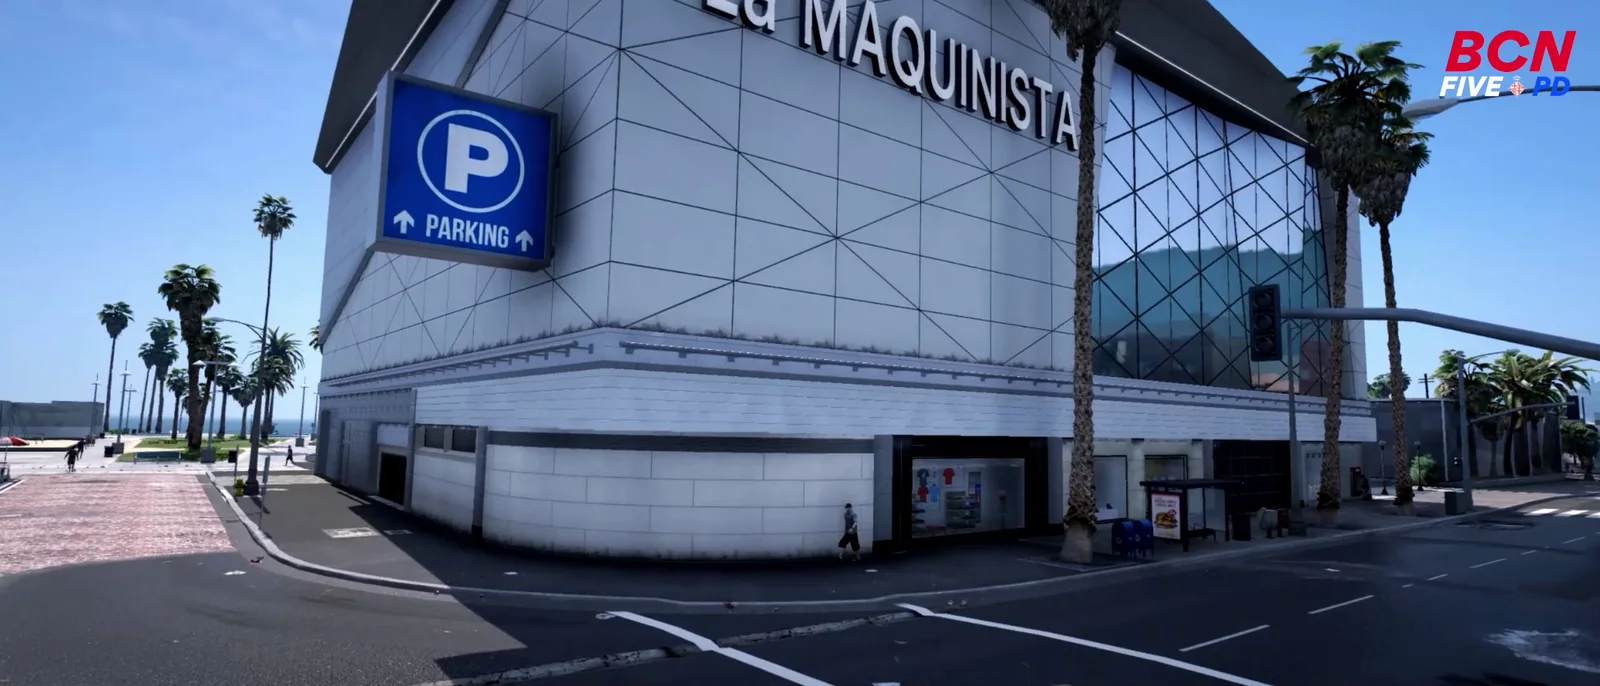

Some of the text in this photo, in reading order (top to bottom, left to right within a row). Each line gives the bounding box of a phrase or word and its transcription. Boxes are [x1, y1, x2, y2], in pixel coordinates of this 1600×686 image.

[800, 0, 1078, 152] MAQUINISTA
[444, 123, 508, 193] P
[425, 213, 509, 248] PARKING
